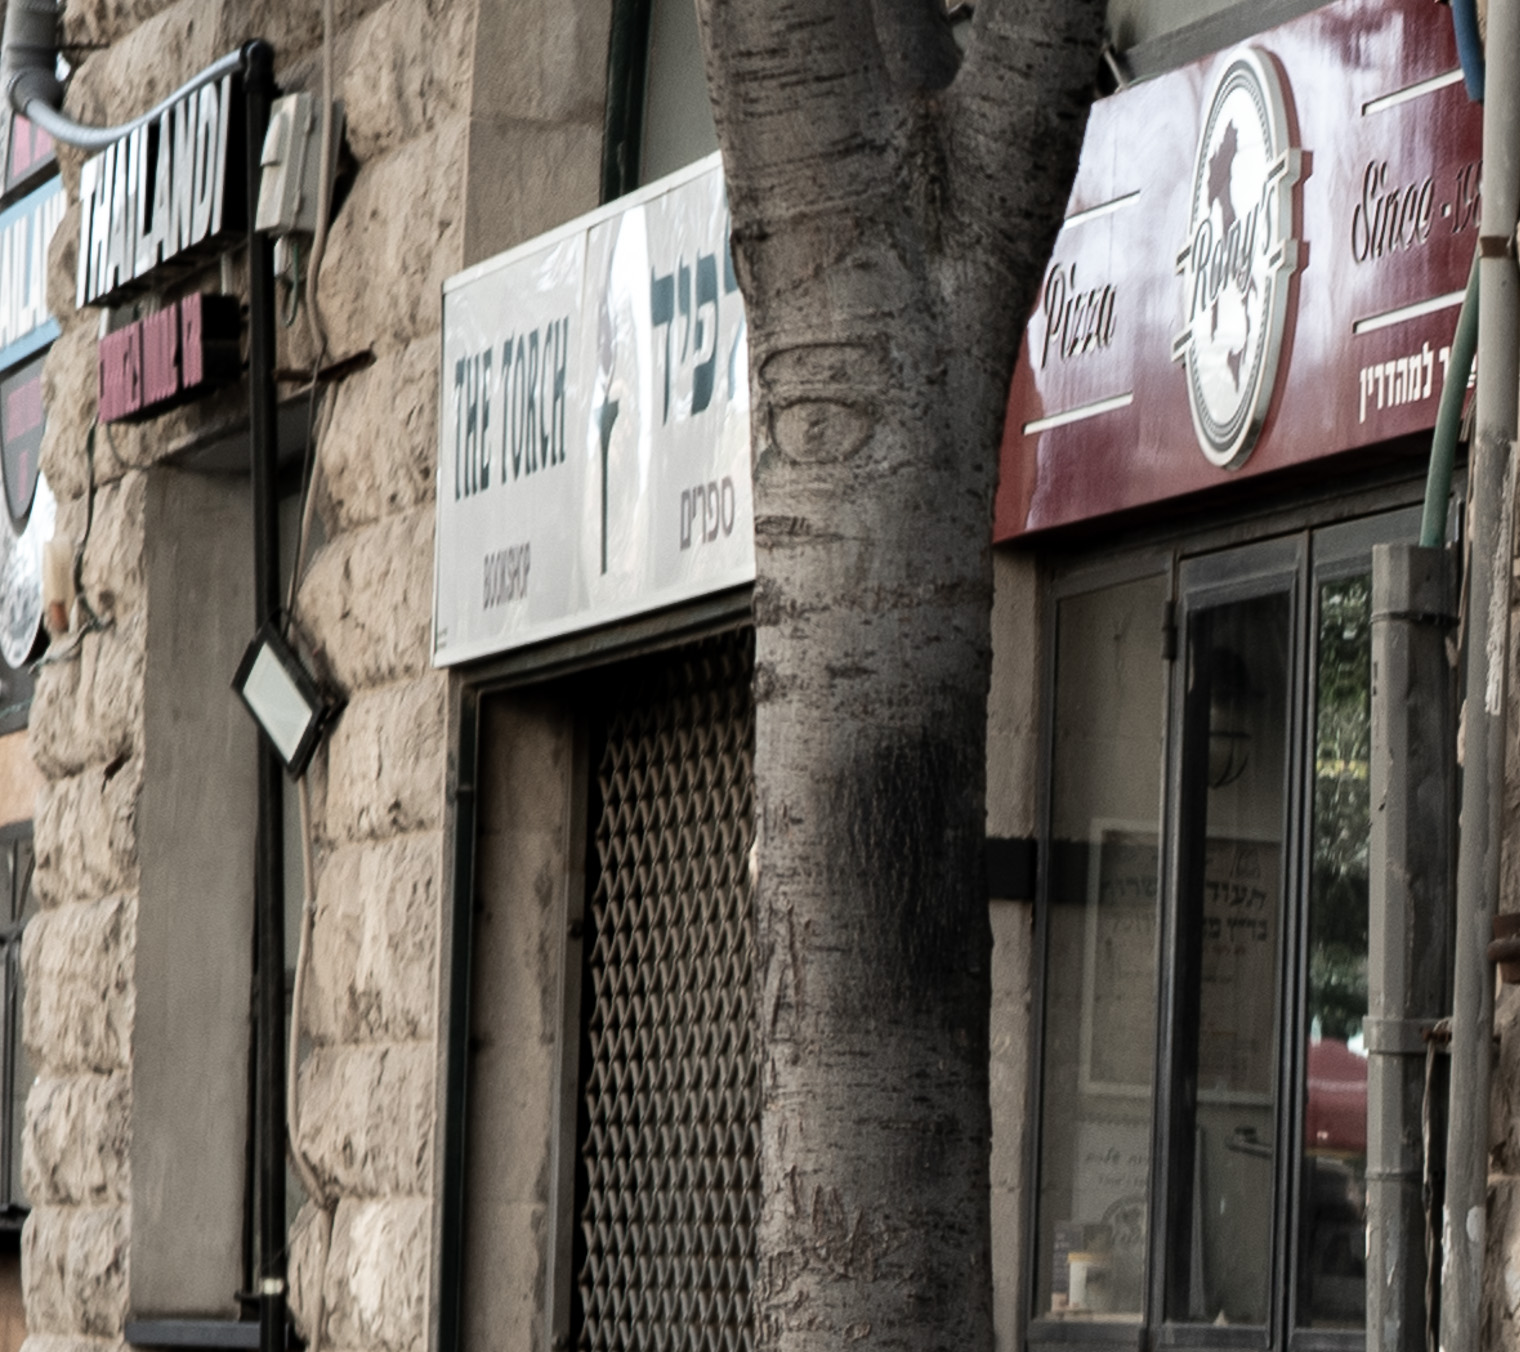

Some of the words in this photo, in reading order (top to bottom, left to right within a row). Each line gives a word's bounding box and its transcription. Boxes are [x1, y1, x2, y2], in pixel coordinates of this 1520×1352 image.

[1352, 160, 1434, 265] Since
[1040, 262, 1117, 369] Pizza
[455, 347, 492, 503] THE
[501, 315, 569, 486] TORCH
[1359, 341, 1434, 424] למהדרין
[680, 475, 736, 552] ספרים
[483, 541, 531, 611] BOOKSHOP
